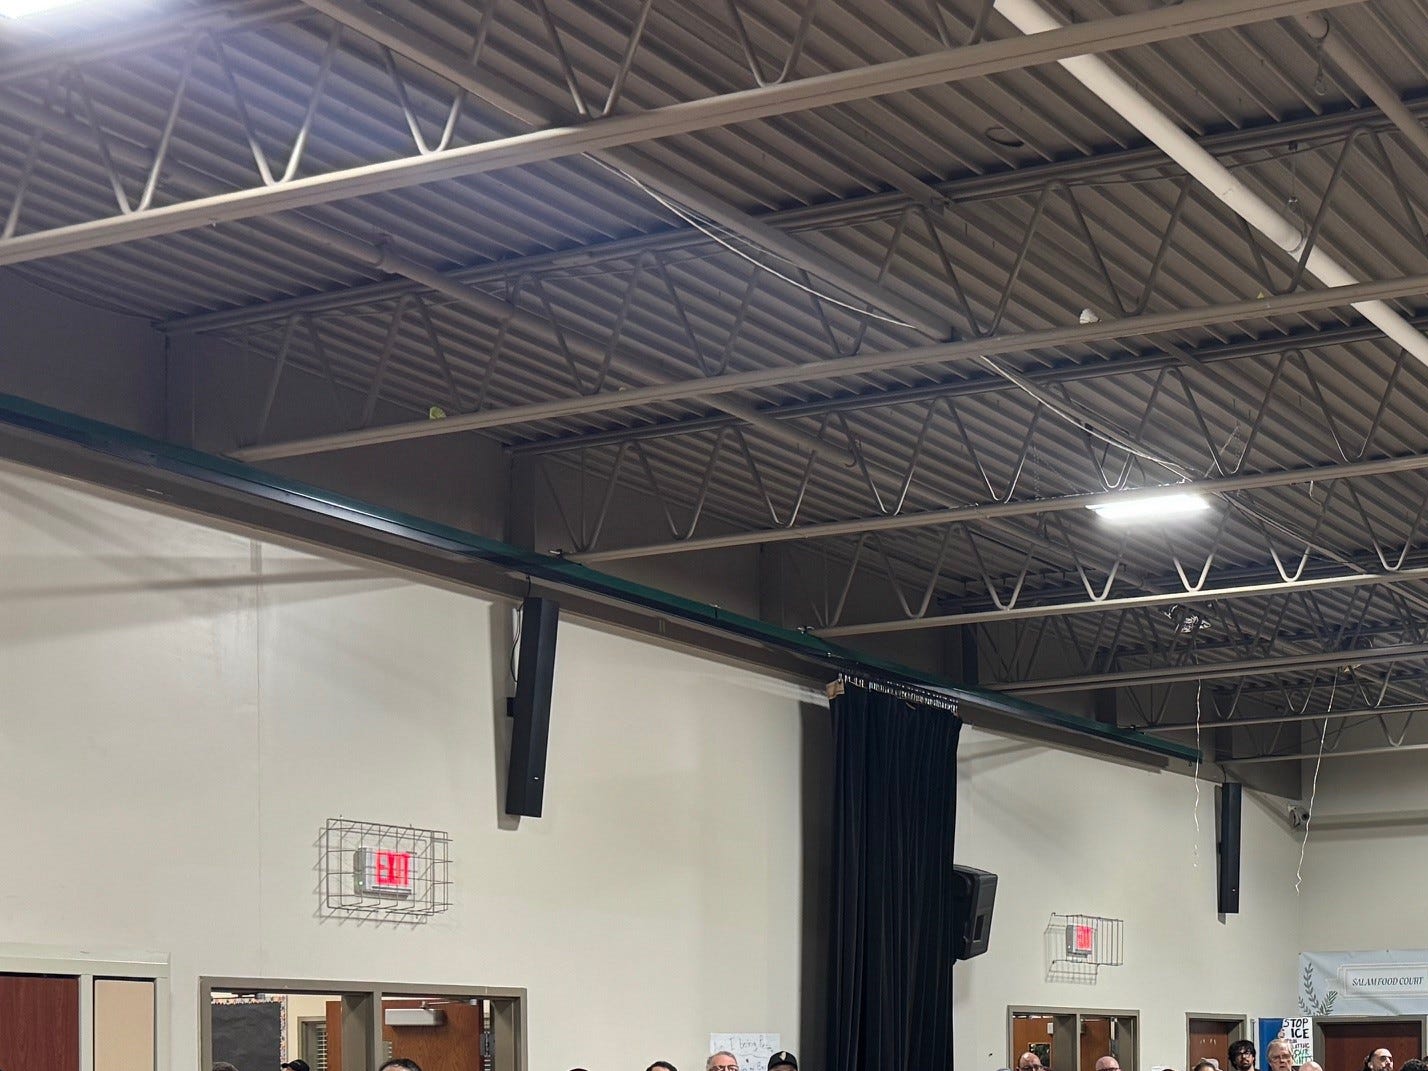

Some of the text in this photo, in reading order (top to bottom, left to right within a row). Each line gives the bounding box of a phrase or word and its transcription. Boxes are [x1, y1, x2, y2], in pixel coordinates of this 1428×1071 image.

[376, 849, 409, 886] EXIT
[1352, 976, 1424, 986] SALAM FOOD COURT
[1283, 1018, 1308, 1028] STOP
[1291, 1028, 1309, 1038] ICE
